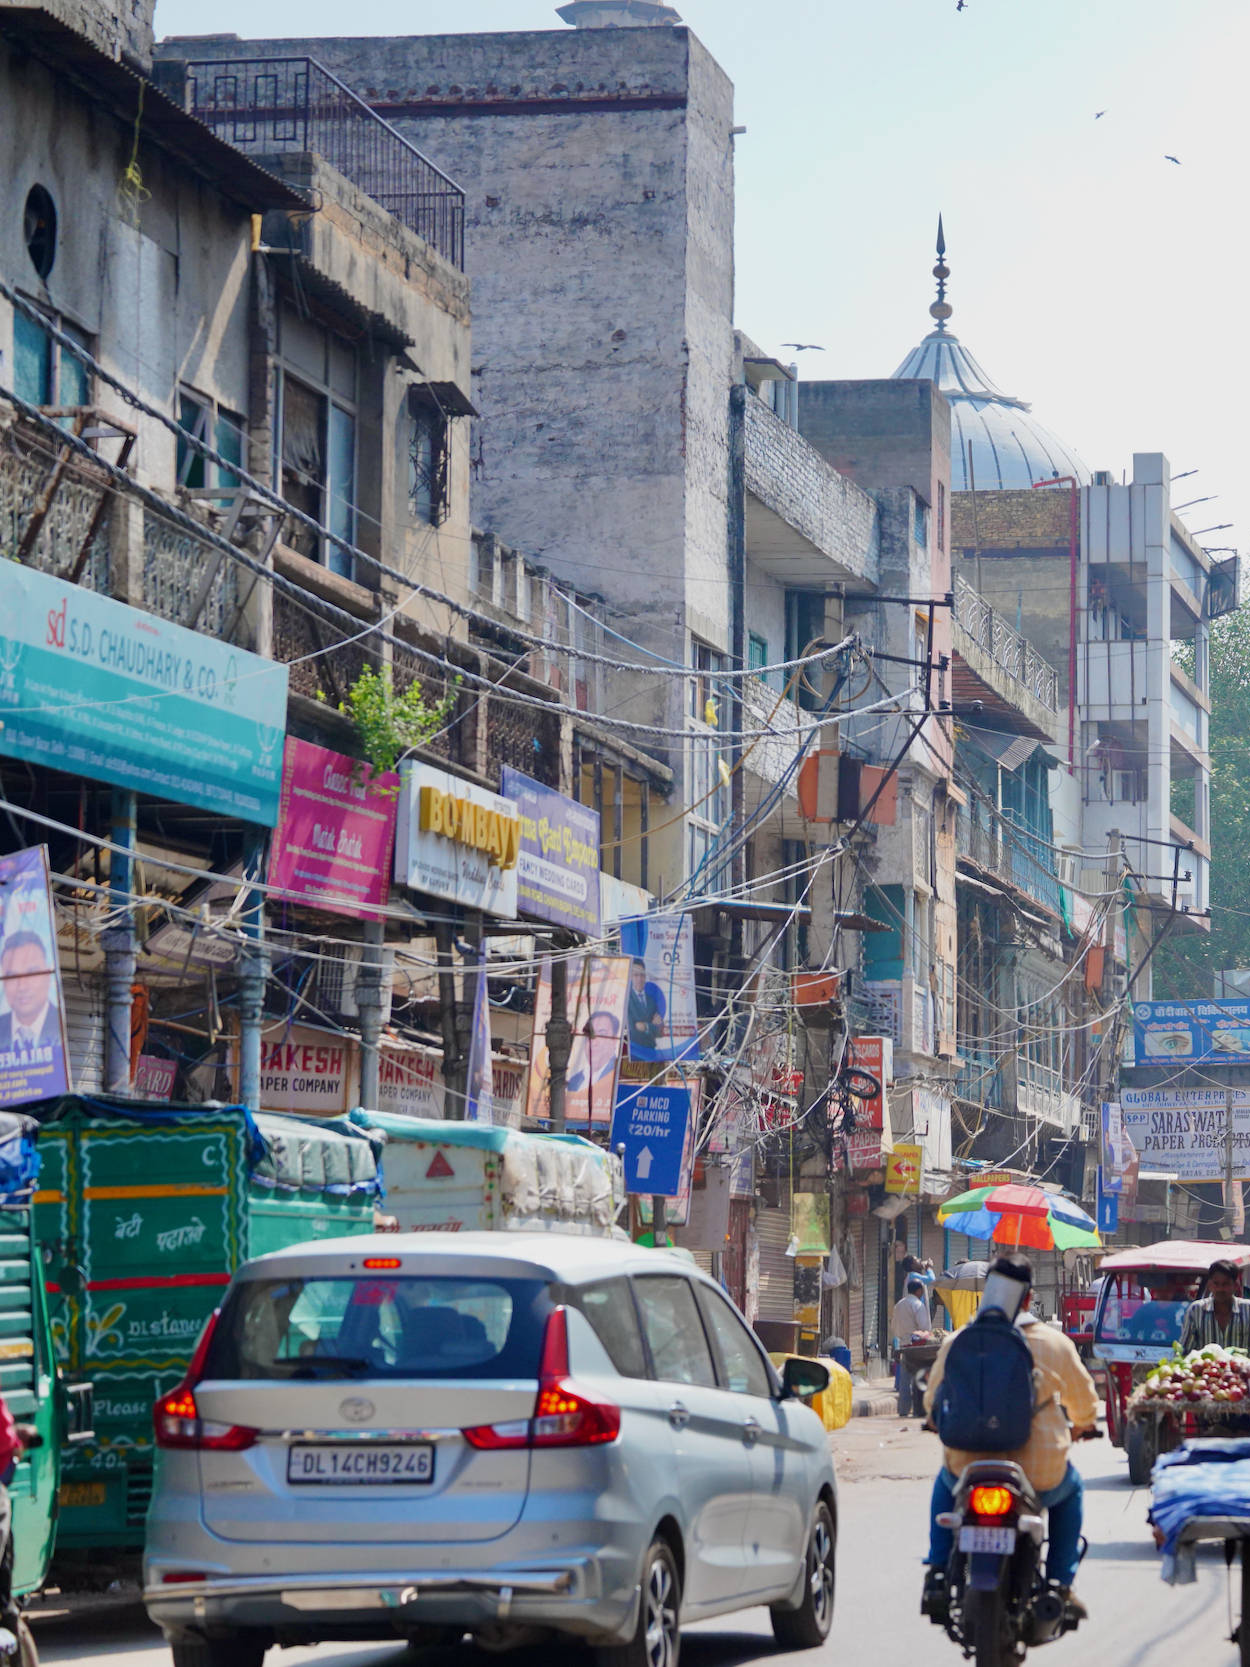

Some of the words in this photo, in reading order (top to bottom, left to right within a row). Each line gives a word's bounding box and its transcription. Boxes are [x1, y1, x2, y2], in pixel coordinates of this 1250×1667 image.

[70, 618, 94, 655] S.D.
[100, 630, 182, 688] CHAUDHARY
[183, 660, 194, 691] &
[197, 665, 218, 700] CO.
[420, 786, 521, 870] BOMBAYY
[293, 1078, 340, 1095] COMPANY
[401, 1089, 432, 1104] COMPANY
[650, 1097, 669, 1109] MCD
[1126, 1093, 1167, 1104] GLOBAL
[632, 1108, 670, 1123] PARKING
[1151, 1111, 1229, 1134] SARASWAT
[1145, 1135, 1185, 1150] PAPER
